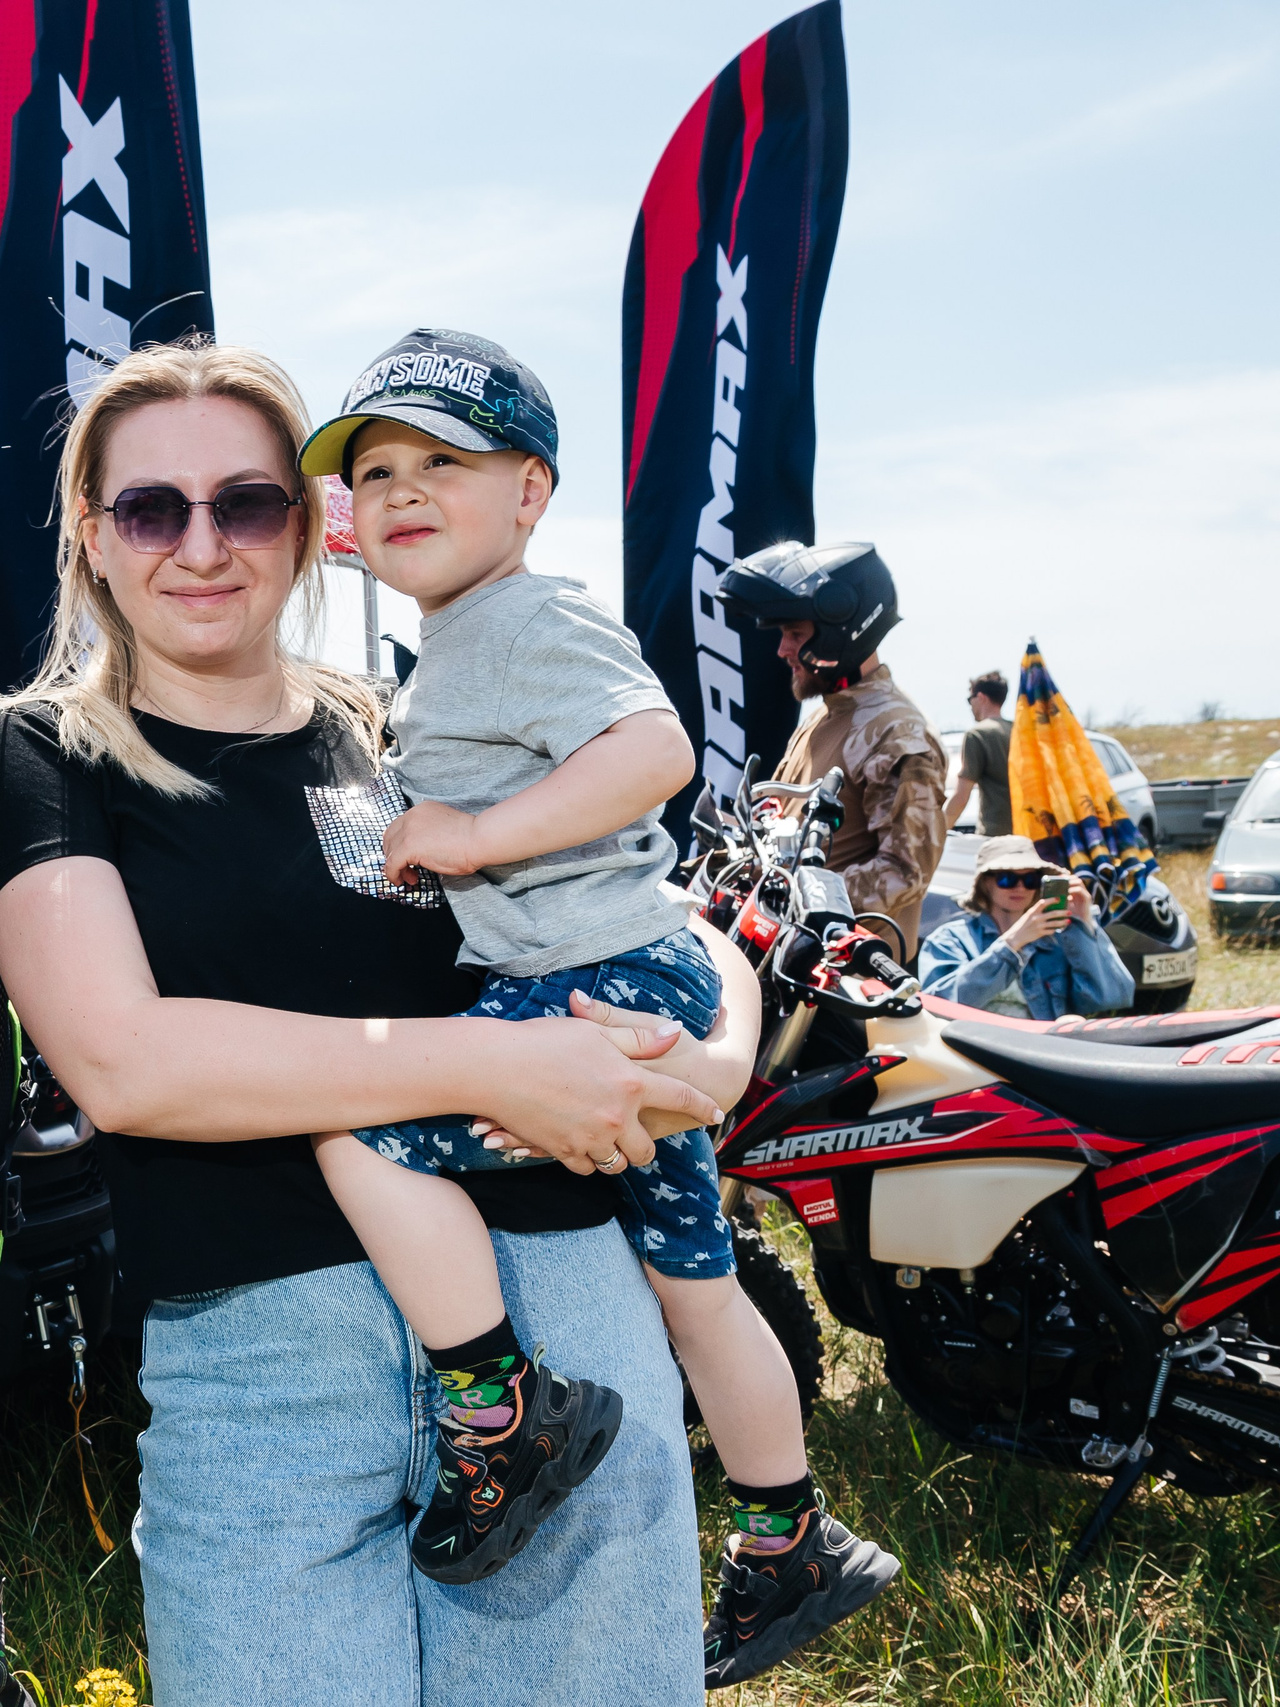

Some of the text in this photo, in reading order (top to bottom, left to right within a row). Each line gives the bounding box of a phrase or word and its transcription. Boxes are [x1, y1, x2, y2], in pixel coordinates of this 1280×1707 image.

[742, 1115, 946, 1166] SHARMAX
[756, 1161, 795, 1172] MOTORS
[805, 1201, 834, 1214] MOTUL
[807, 1211, 837, 1225] KENDA
